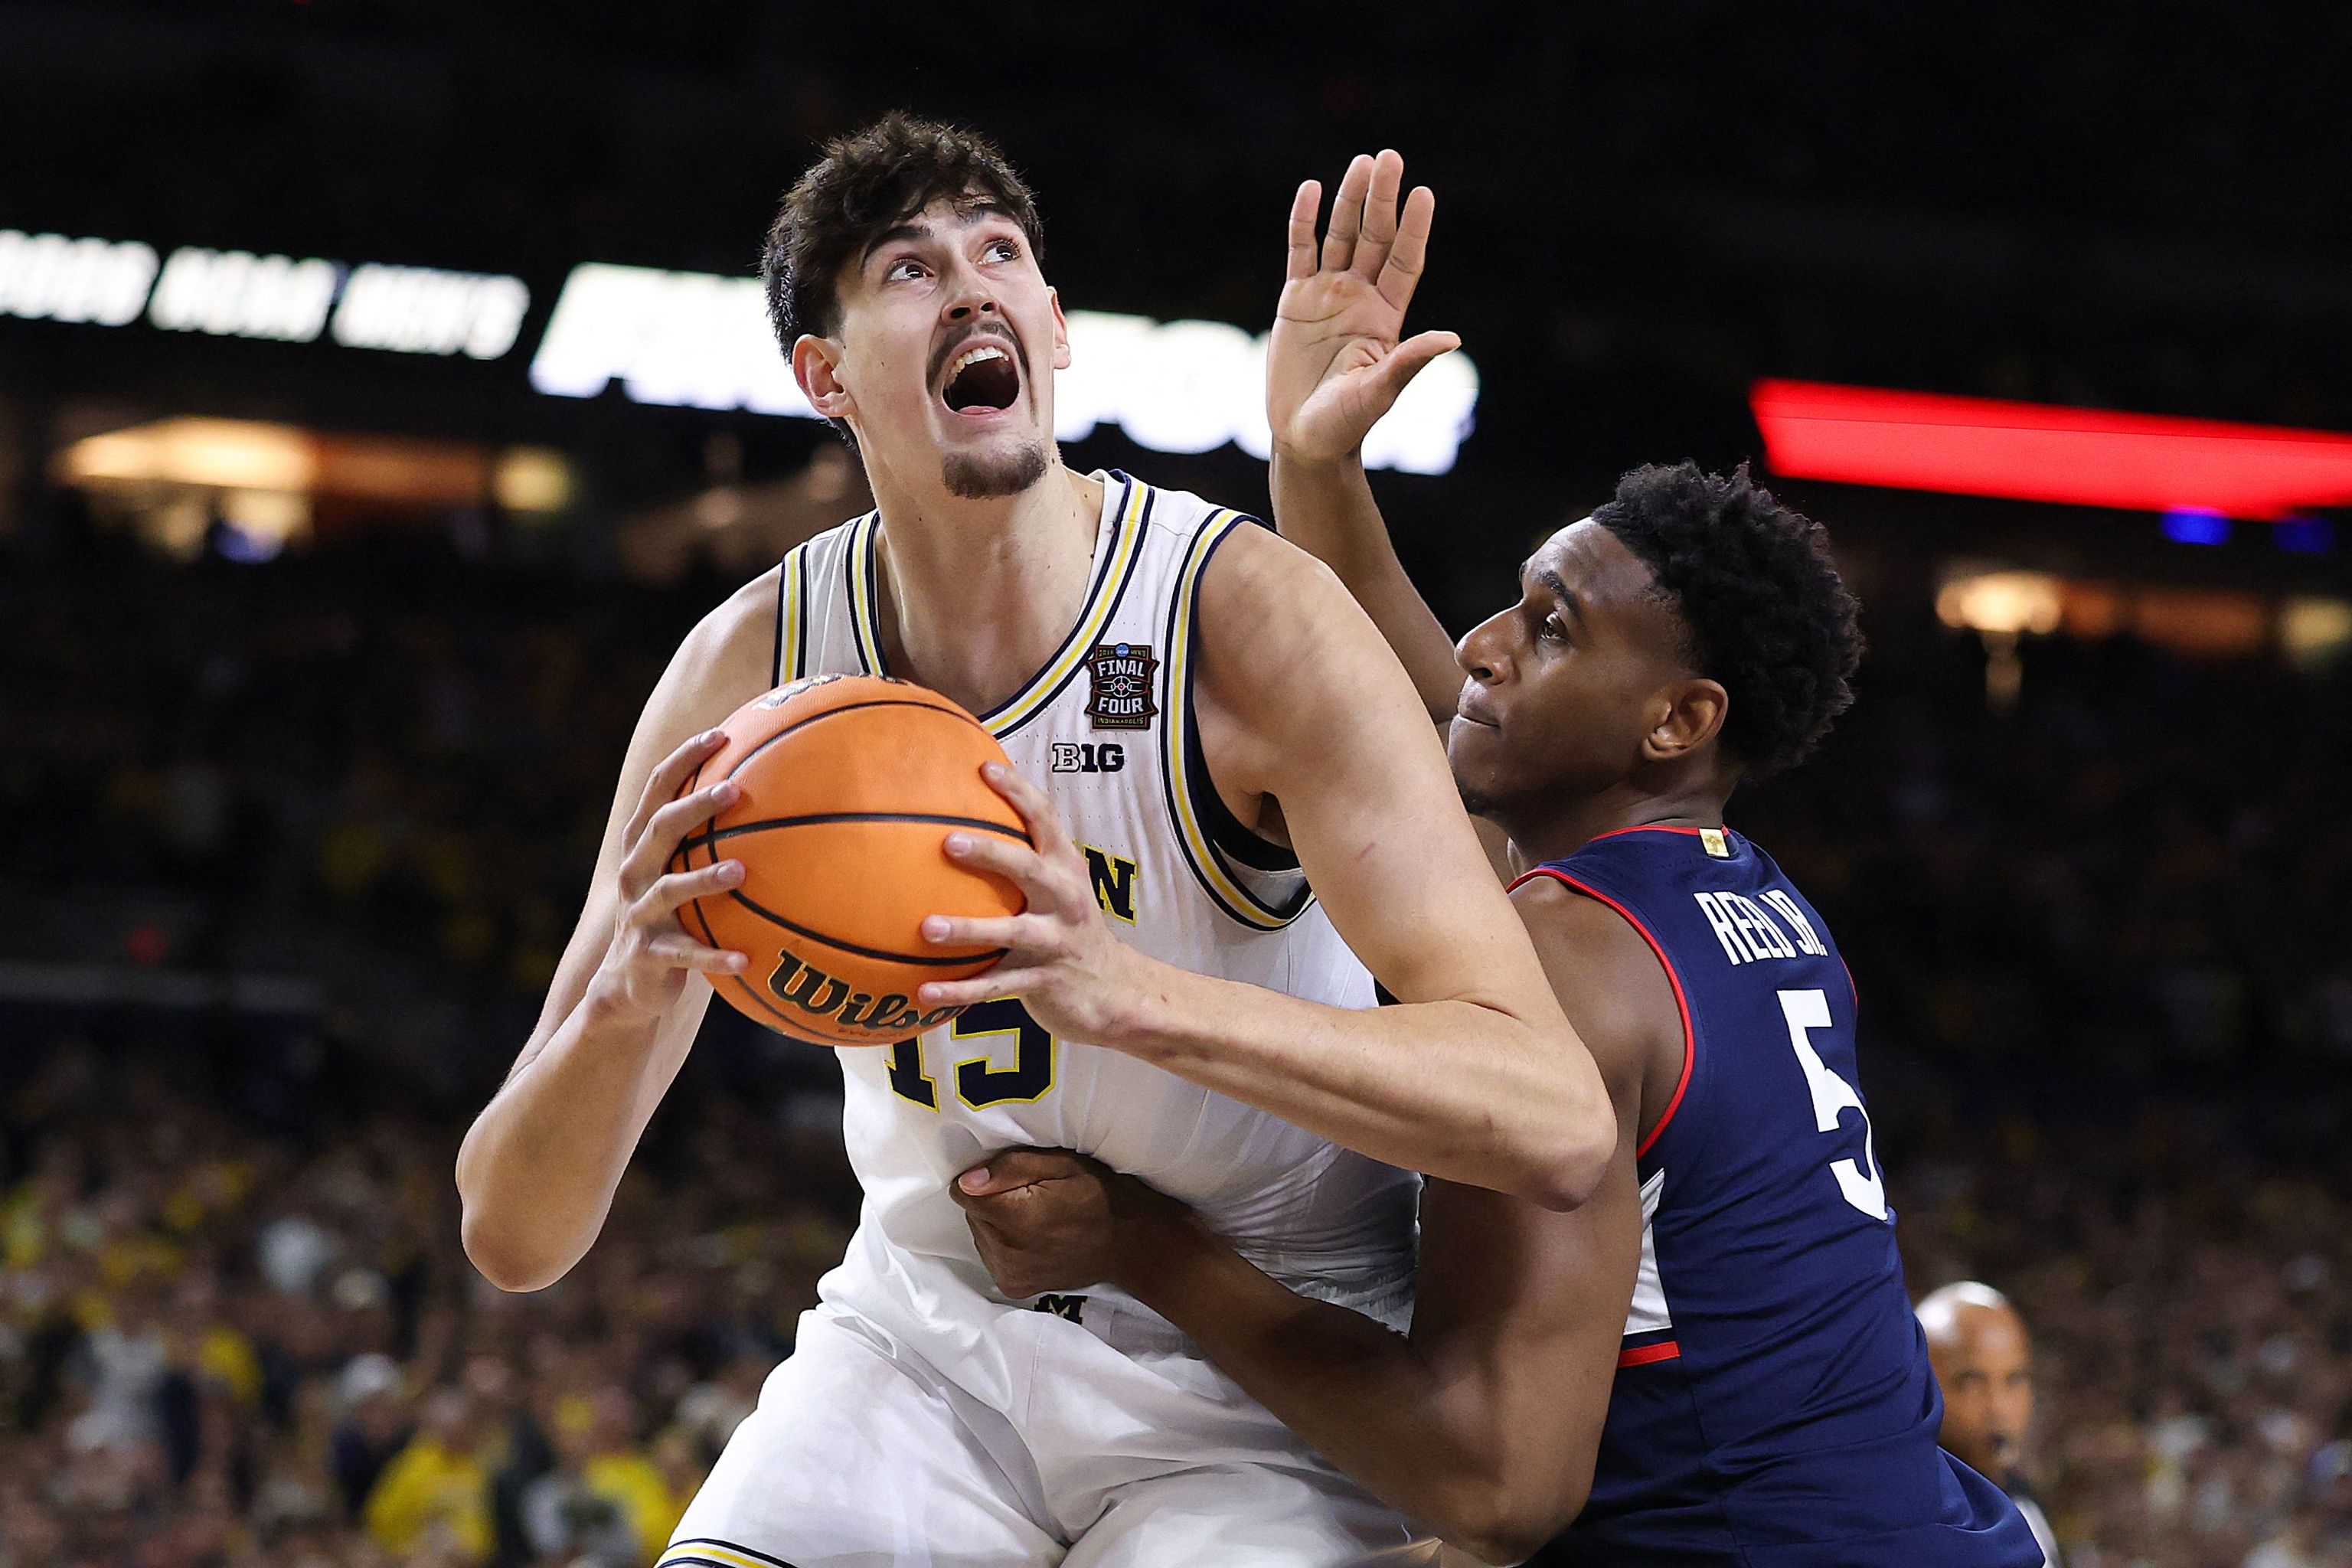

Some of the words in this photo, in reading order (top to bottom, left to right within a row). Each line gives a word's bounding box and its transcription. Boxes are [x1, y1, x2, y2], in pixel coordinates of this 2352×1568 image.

[1097, 659, 1145, 677] FINAL
[1098, 697, 1144, 714] FOUR
[1694, 891, 1797, 965] REED
[1758, 889, 1828, 956] JR.
[767, 948, 969, 1029] Wilso
[884, 995, 1056, 1113] 15
[1776, 989, 1888, 1221] 5
